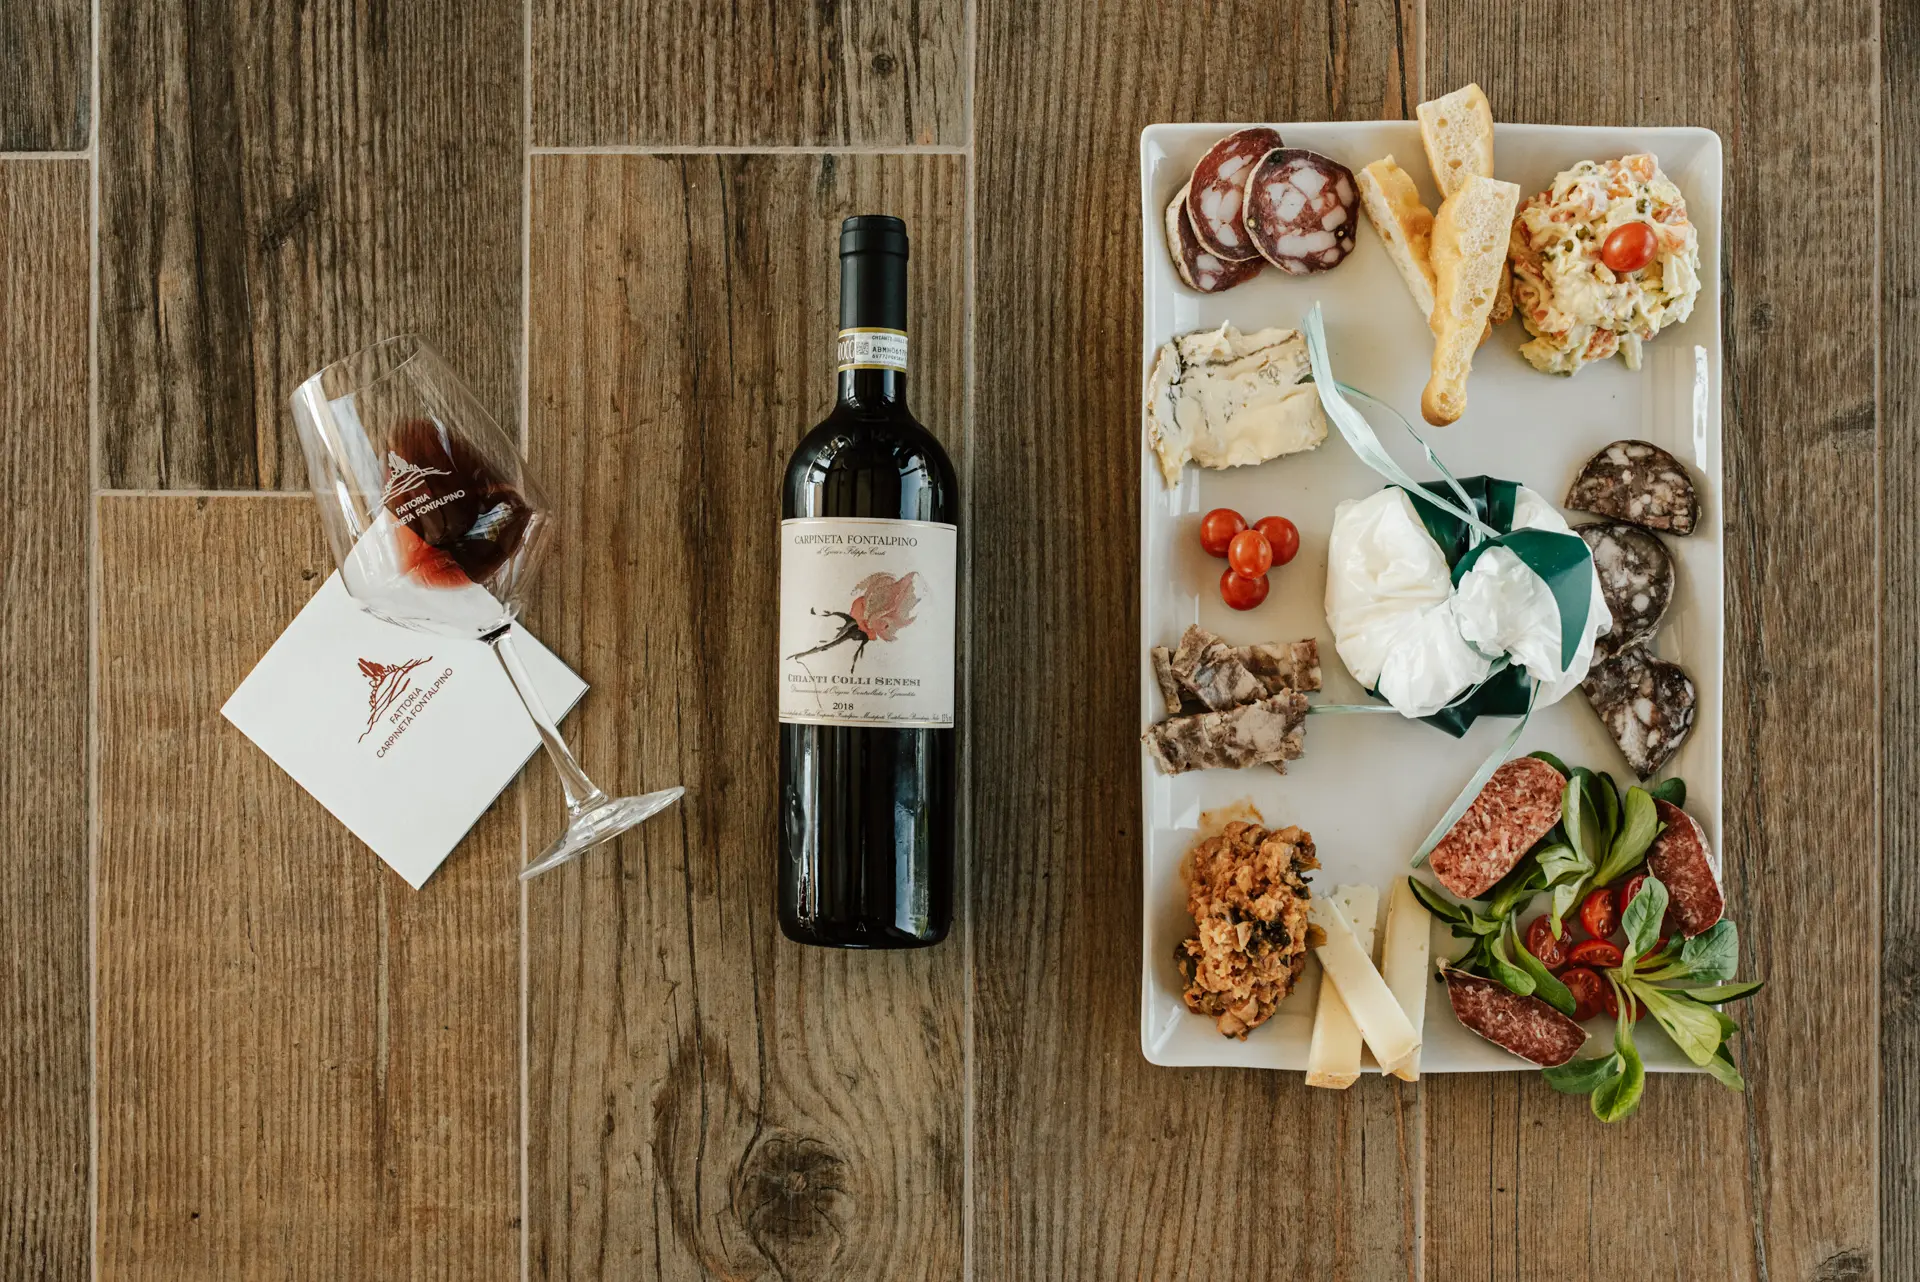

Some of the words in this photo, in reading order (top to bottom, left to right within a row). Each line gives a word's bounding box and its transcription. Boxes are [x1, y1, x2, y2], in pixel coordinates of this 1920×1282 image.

[396, 493, 431, 516] FATTORIA
[416, 489, 466, 517] FONTALPINO
[794, 534, 843, 545] CARPINETA
[847, 535, 918, 547] FONTALPINO
[787, 673, 828, 683] CHIANTI
[831, 675, 871, 685] COLLI
[875, 676, 921, 687] SENESI
[376, 716, 414, 759] CARPINETA
[410, 667, 453, 718] FONTALPINO
[389, 687, 423, 725] FATTORIA
[832, 702, 854, 711] 2018
